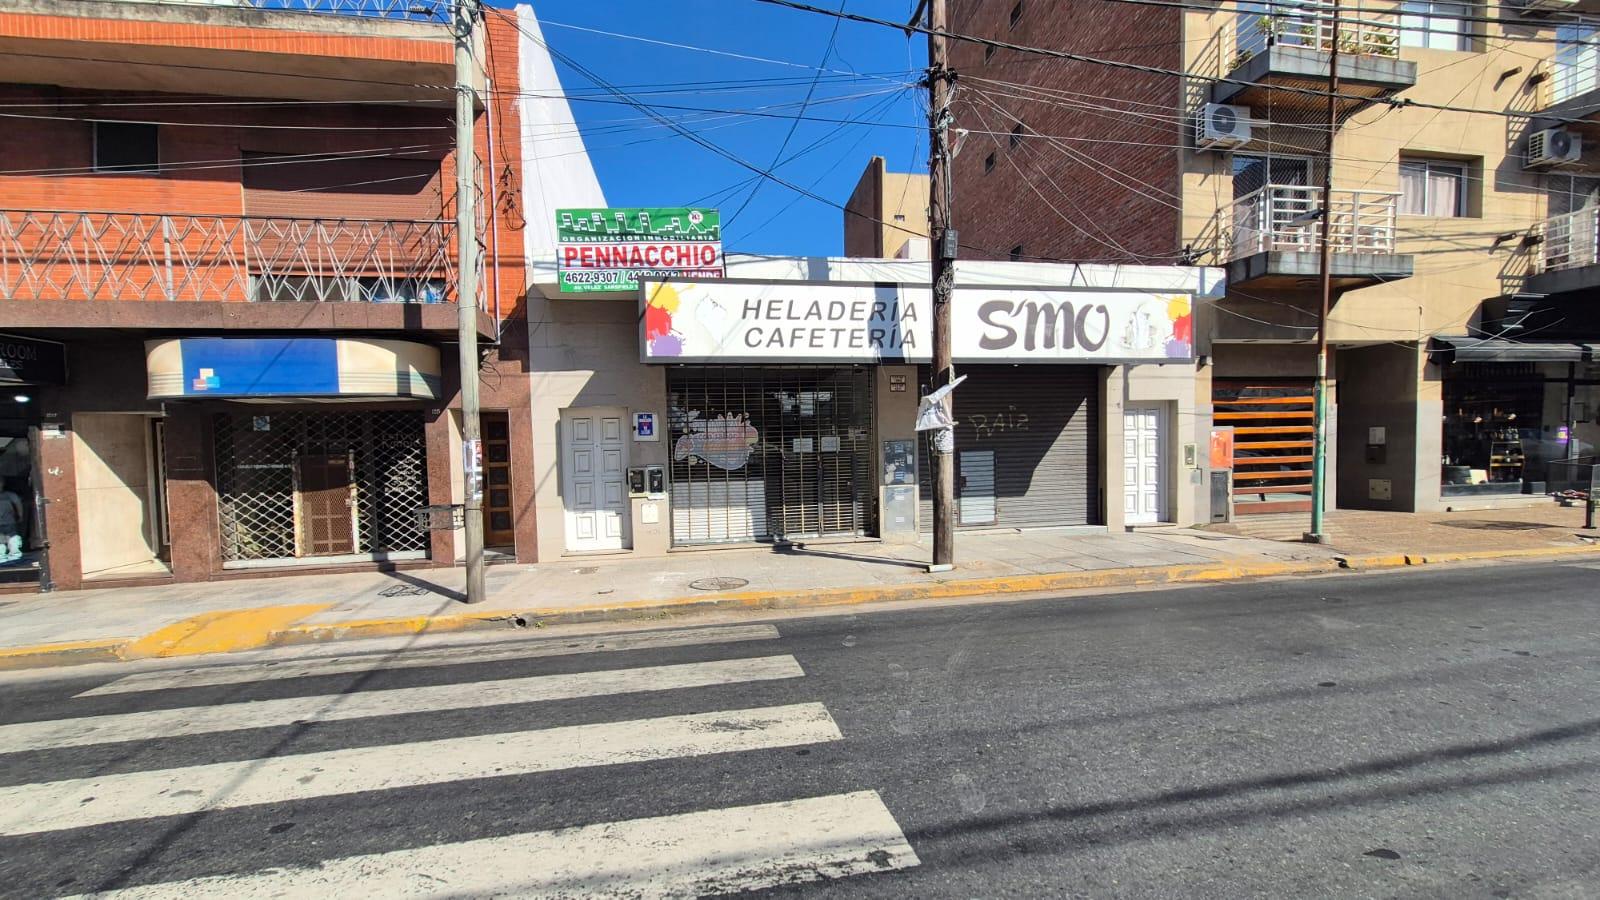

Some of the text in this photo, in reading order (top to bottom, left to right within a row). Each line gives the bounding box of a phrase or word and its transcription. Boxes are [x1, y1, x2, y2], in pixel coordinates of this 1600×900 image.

[564, 245, 716, 268] PENNACCHIO
[565, 272, 618, 284] 4622-9307
[741, 297, 919, 323] HELADERÍA
[744, 325, 917, 350] CAFETERÍA
